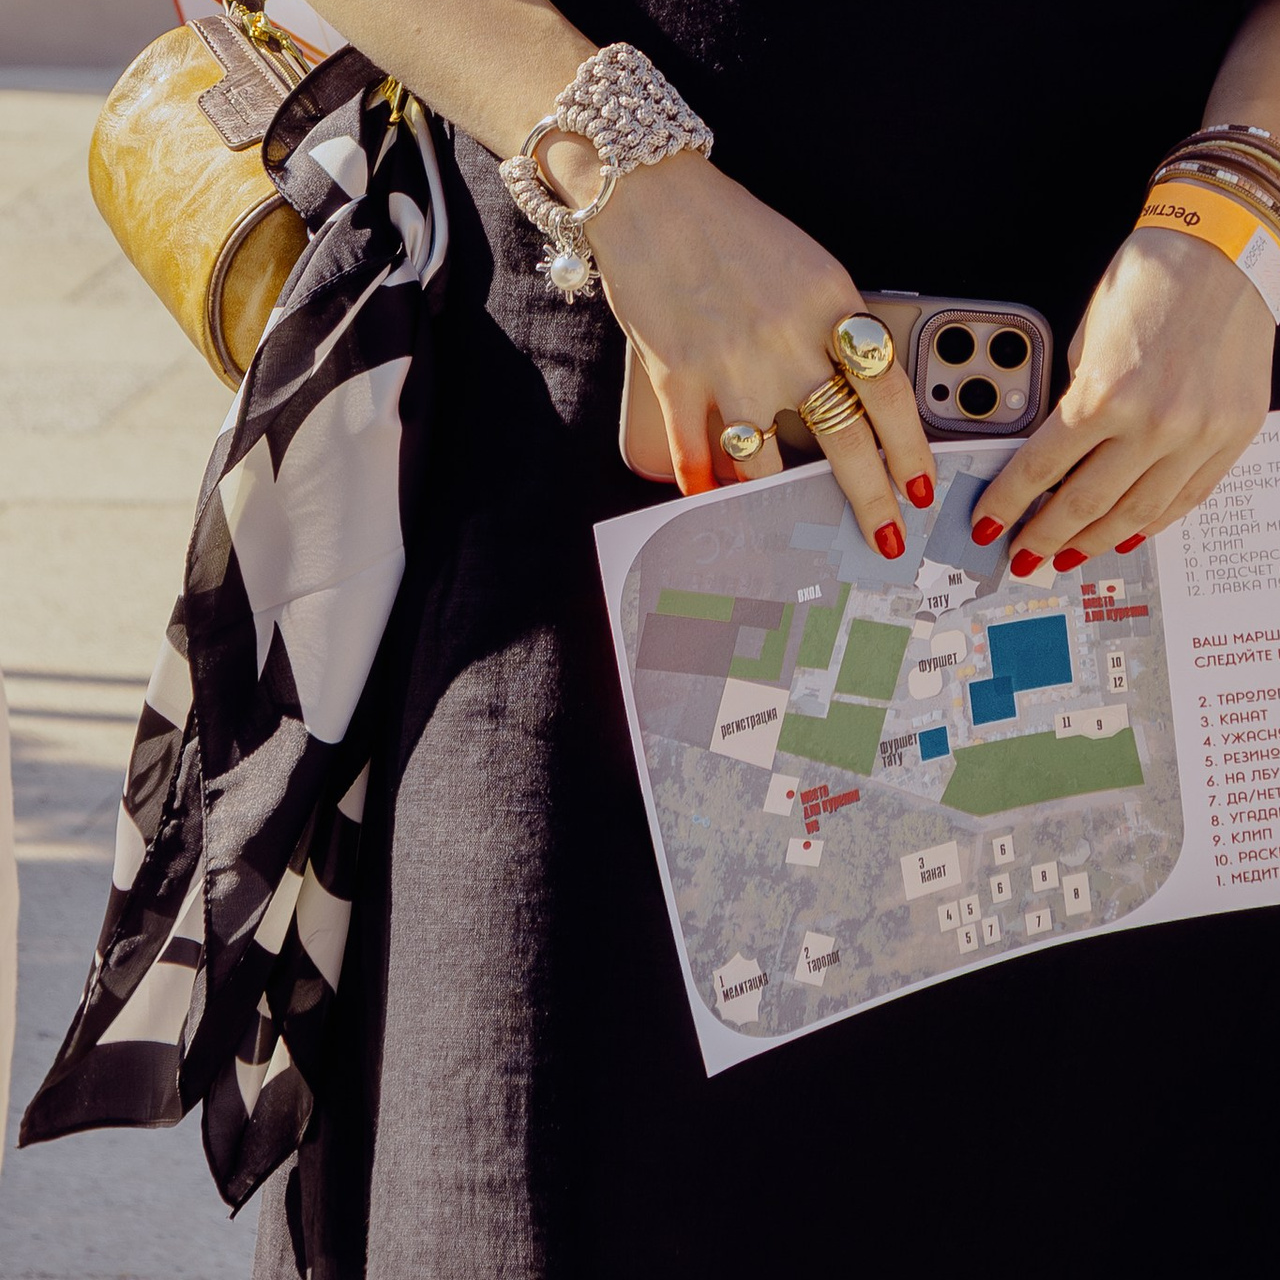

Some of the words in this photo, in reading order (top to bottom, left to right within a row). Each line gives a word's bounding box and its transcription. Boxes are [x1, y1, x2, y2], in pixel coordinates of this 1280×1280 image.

[1224, 494, 1253, 508] ЛБУ
[1199, 508, 1255, 526] ДА/НЕТ
[1182, 529, 1195, 540] 8.
[1200, 520, 1261, 539] УГАДАЙ
[1183, 543, 1196, 555] 9.
[1202, 538, 1244, 554] КЛИП
[1184, 557, 1202, 569] 10.
[1186, 571, 1199, 582] 11.
[1205, 563, 1274, 581] ПОДСЧЕТ
[1187, 585, 1206, 597] 12.
[1210, 579, 1262, 595] ЛАВКА
[1192, 634, 1228, 649] ВАШ
[1111, 656, 1122, 668] 10
[1194, 648, 1273, 668] СЛЕДУЙТЕ
[1113, 676, 1124, 689] 12
[1198, 696, 1212, 708] 2.
[720, 707, 778, 740] регистрация
[1062, 716, 1071, 729] 11
[1096, 719, 1103, 731] 9
[1200, 716, 1214, 728] 3.
[1219, 709, 1268, 726] КАНАТ
[1202, 736, 1216, 747] 4.
[1204, 756, 1218, 768] 5.
[1206, 775, 1220, 787] 6.
[1225, 771, 1246, 785] НА
[1251, 767, 1280, 782] ЛБУ
[1208, 794, 1221, 807] 7.
[1211, 815, 1224, 827] 8.
[1212, 834, 1226, 847] 9.
[1231, 827, 1273, 845] КЛИП
[1000, 843, 1006, 856] 6
[918, 856, 925, 869] 3
[1214, 854, 1233, 867] 10.
[1041, 870, 1048, 882] 8
[1216, 875, 1226, 887] 1.
[997, 882, 1004, 895] 6
[1073, 888, 1080, 900] 8
[946, 909, 952, 921] 4
[967, 903, 974, 916] 5
[1036, 915, 1041, 928] 7
[988, 924, 993, 937] 7
[965, 931, 972, 944] 5
[804, 946, 810, 959] 2
[719, 975, 724, 988] 1
